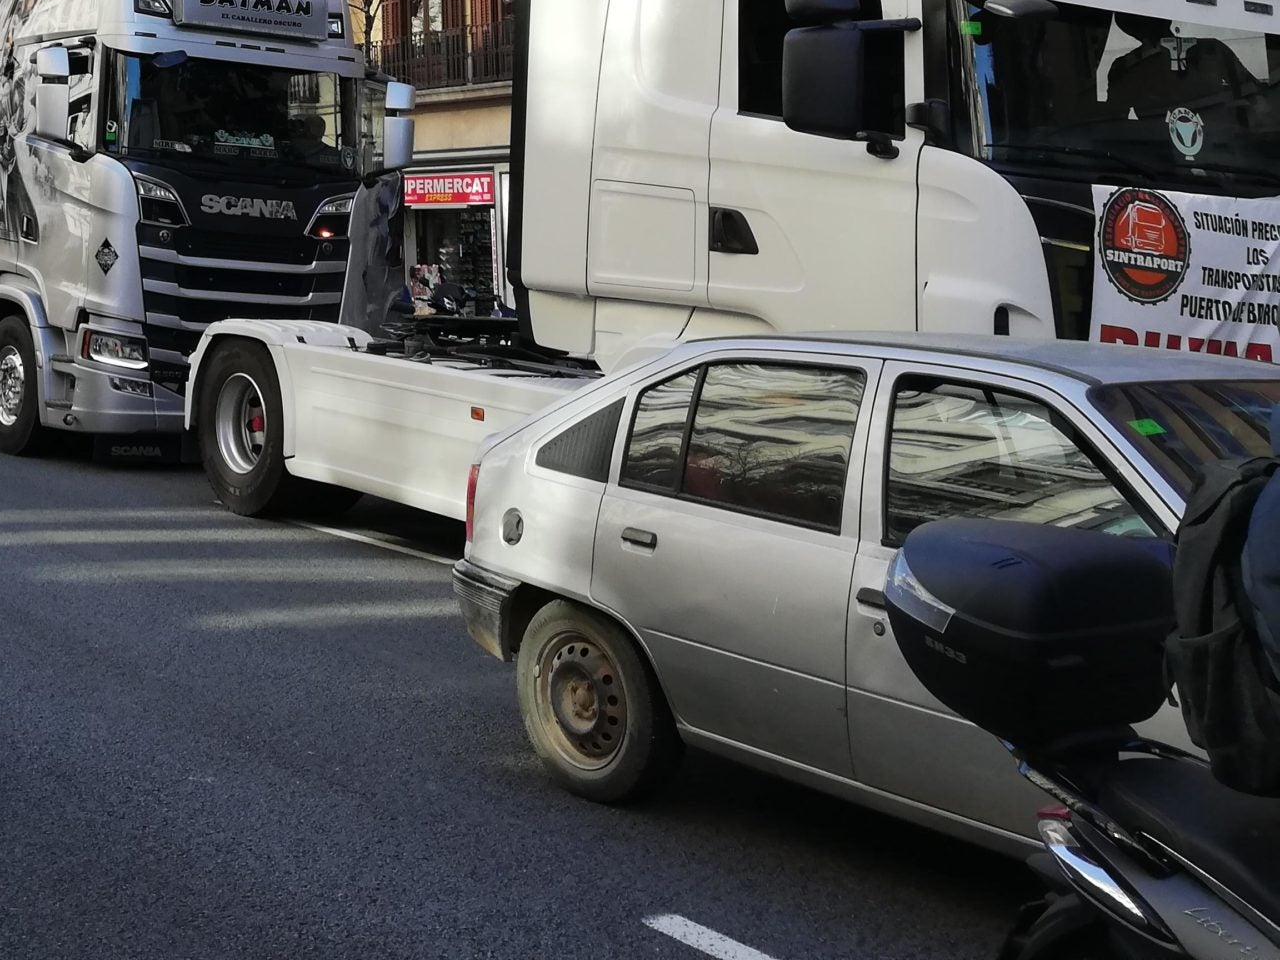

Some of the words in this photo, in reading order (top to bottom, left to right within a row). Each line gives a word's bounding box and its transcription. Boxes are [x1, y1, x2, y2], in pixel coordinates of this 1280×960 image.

[232, 14, 273, 25] CABALLERO
[273, 20, 302, 28] OSCURO
[200, 194, 298, 220] SCANIA
[425, 193, 453, 202] EXPRESS
[1193, 211, 1249, 238] SITUACIÓN
[1106, 249, 1184, 273] SINTRAPORT
[1246, 246, 1269, 266] LOS
[1180, 294, 1233, 322] PUERTO
[111, 445, 162, 456] SCANIA
